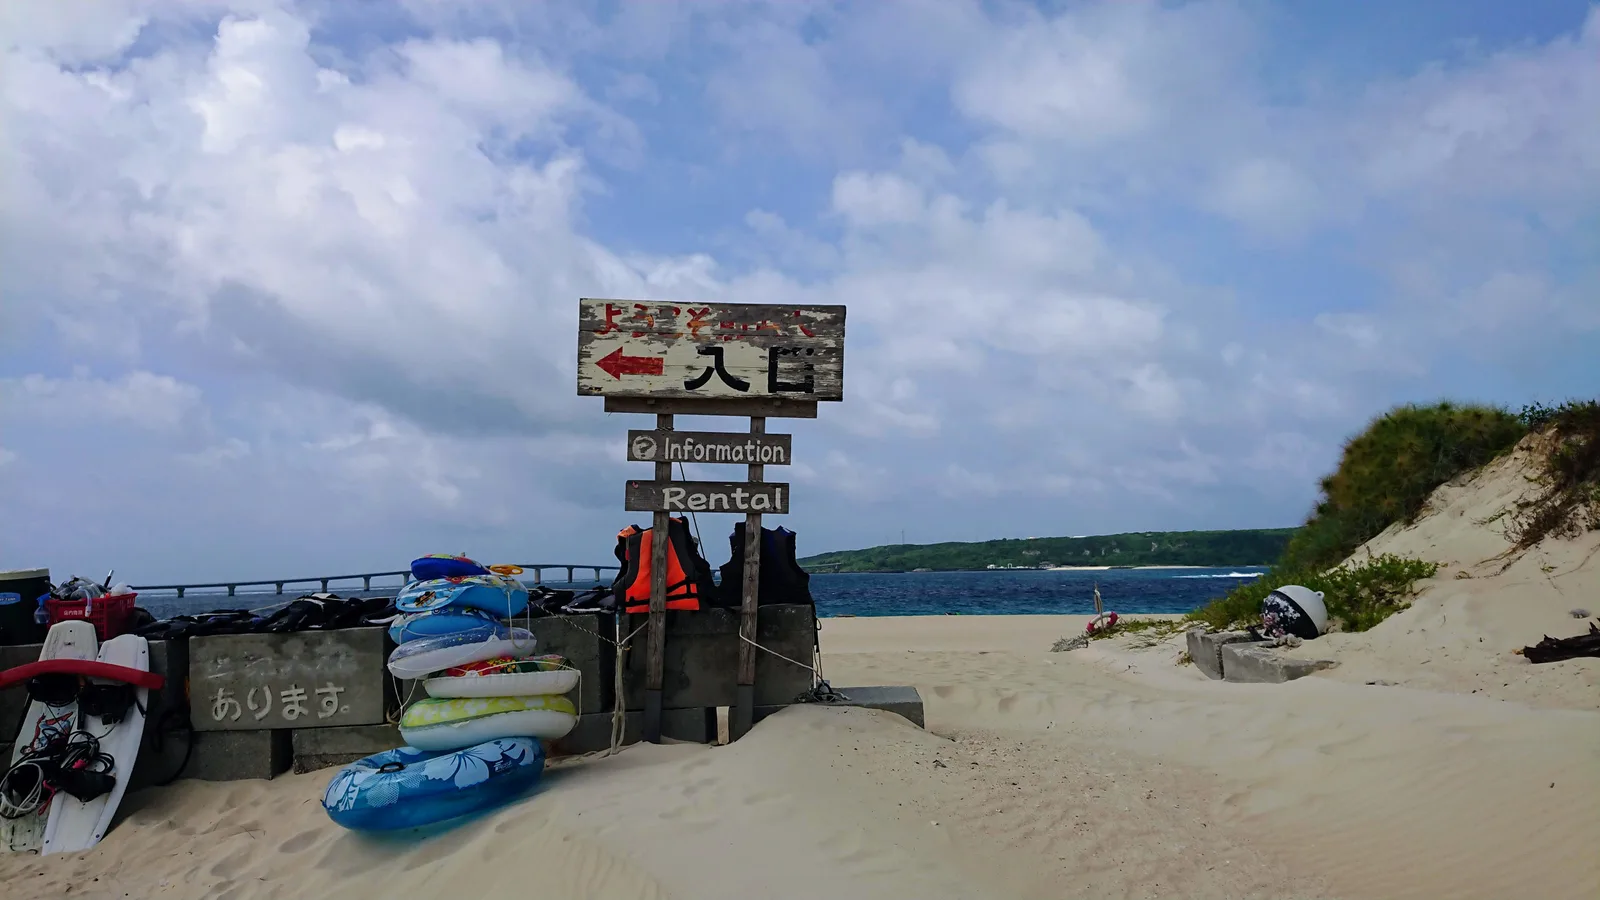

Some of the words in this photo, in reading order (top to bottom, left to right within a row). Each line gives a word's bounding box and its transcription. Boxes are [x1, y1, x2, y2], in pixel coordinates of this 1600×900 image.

[683, 346, 815, 394] 入口
[664, 437, 785, 463] Information
[662, 486, 782, 511] Rental
